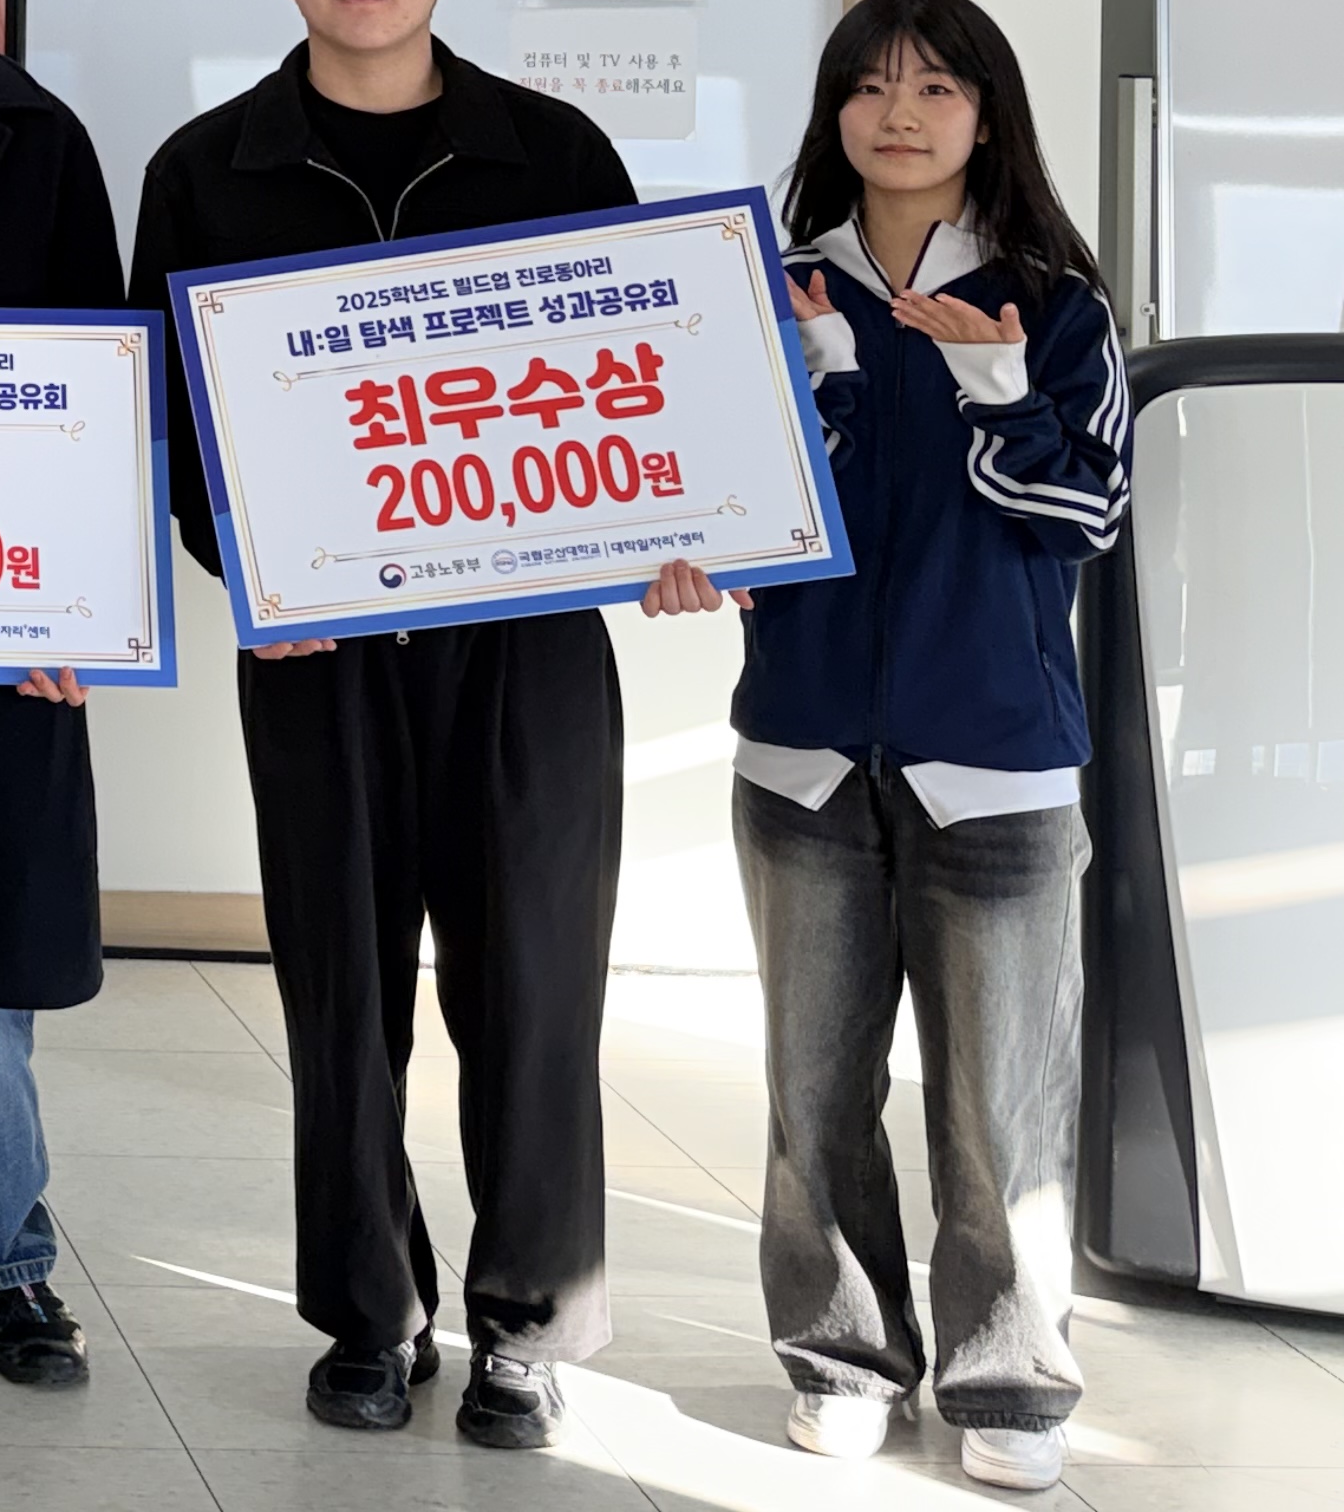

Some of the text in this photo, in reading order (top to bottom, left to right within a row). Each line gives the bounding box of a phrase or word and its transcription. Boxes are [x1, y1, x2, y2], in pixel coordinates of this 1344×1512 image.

[523, 52, 683, 70] 컴퓨터 및 TV 사용 후
[594, 78, 686, 94] 종료해주세요
[336, 256, 612, 313] 2025학년도 빌드업 진로동아리
[287, 278, 679, 357] 내:일 탐색 프로젝트 성과공유회
[344, 341, 665, 451] 최우수상
[367, 434, 684, 532] 200,000원
[410, 557, 481, 580] 고용노동부
